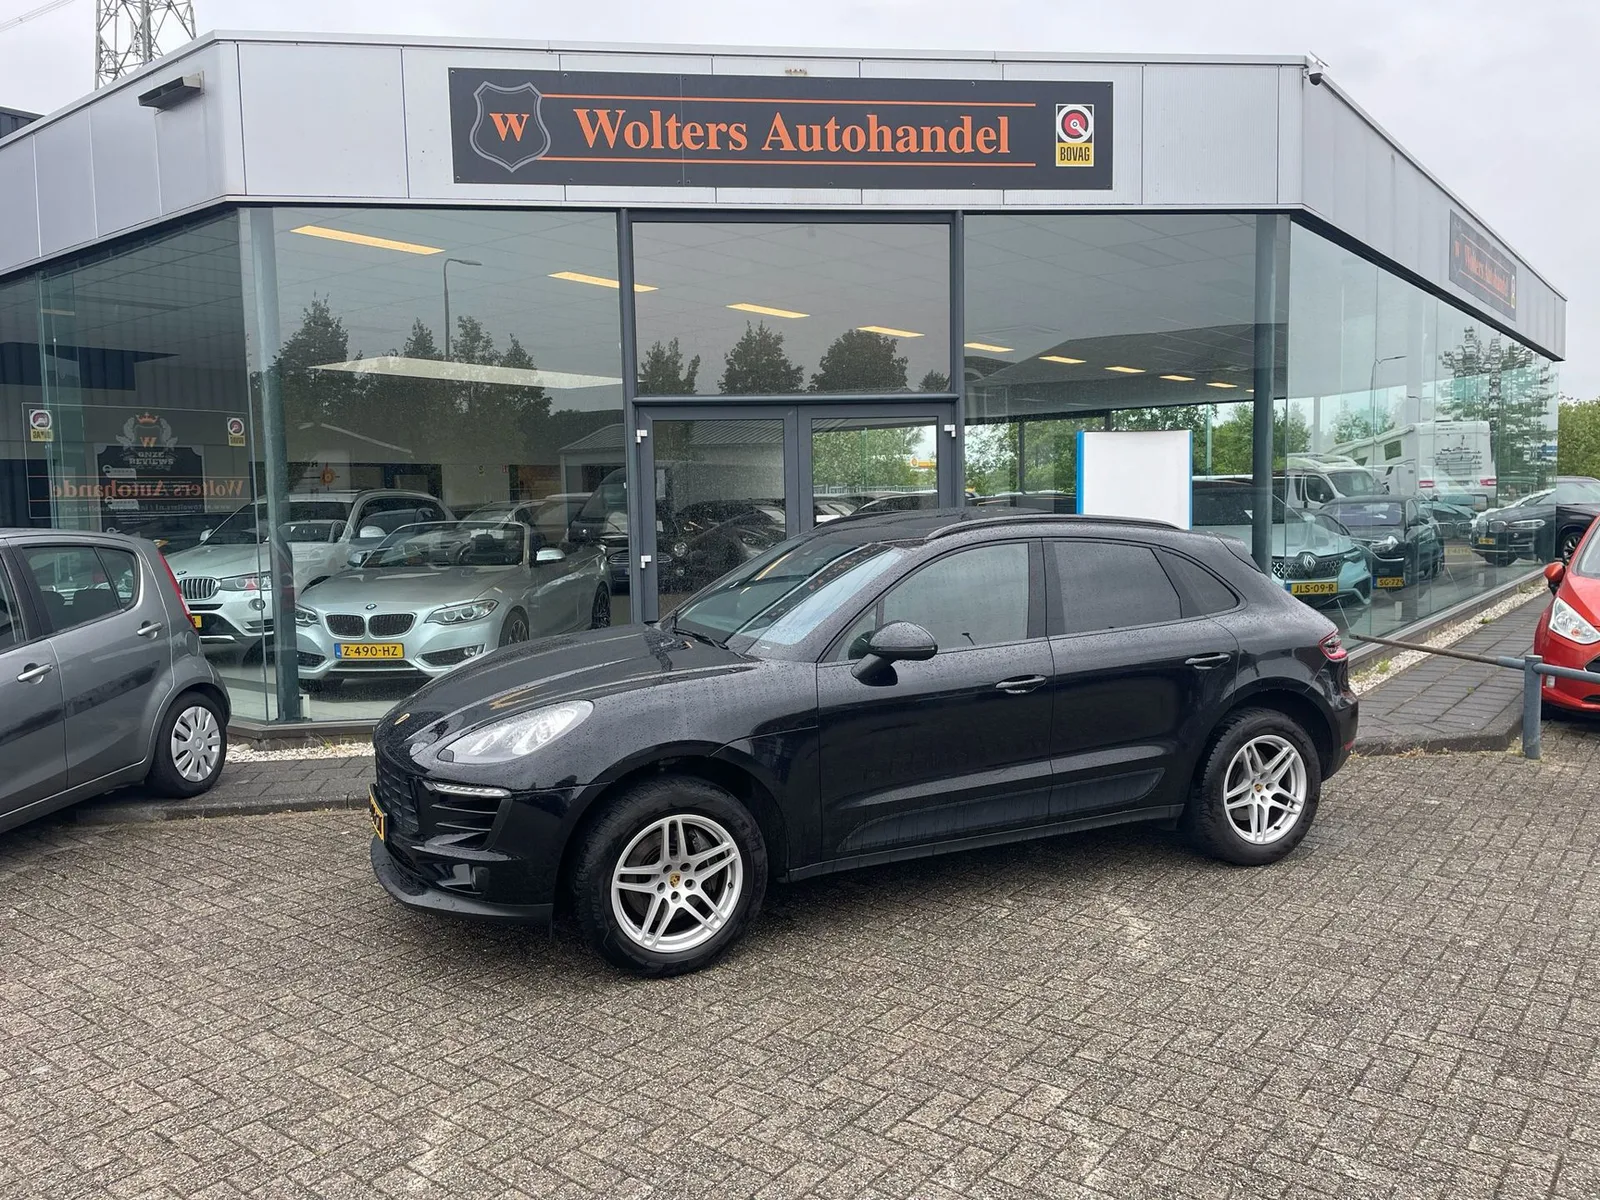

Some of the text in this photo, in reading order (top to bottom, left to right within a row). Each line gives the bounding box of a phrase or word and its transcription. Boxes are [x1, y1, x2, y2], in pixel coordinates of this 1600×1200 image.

[490, 112, 529, 142] W
[574, 108, 1010, 154] Wolters Autohandel
[1060, 146, 1090, 162] BOVAG
[1294, 583, 1334, 594] JLS-09-R
[344, 646, 398, 656] Z-490-HZ
